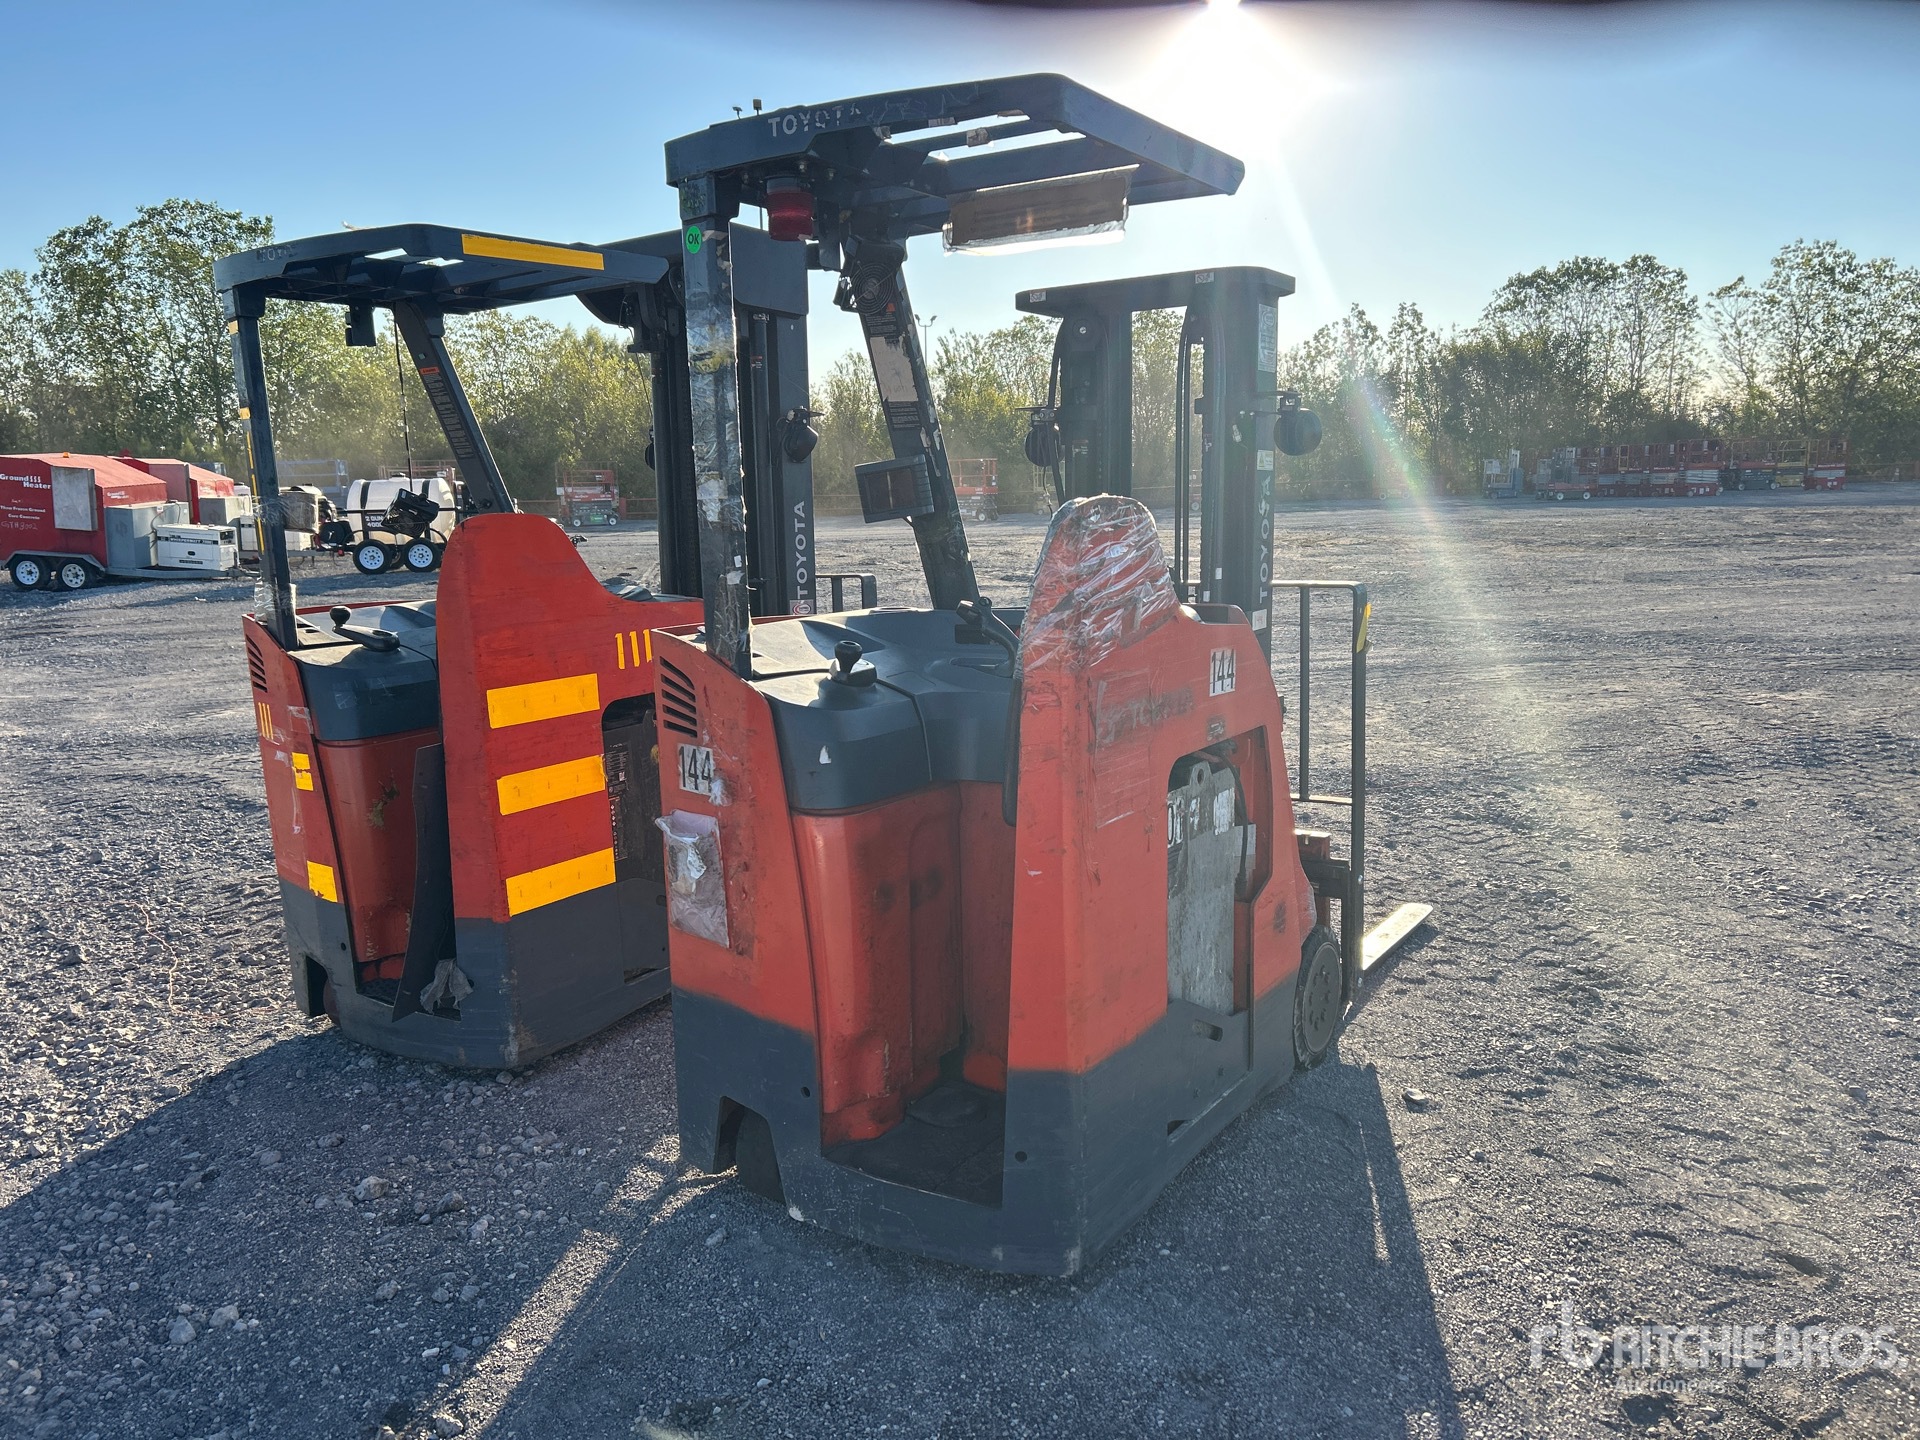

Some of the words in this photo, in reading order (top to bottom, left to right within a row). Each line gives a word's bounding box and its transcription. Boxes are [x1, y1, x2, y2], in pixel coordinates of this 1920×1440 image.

[688, 234, 700, 245] OK
[0, 474, 28, 482] Ground
[23, 481, 52, 490] Heater
[794, 501, 808, 600] TOYOTA
[1211, 648, 1235, 694] 144
[679, 746, 713, 793] 144
